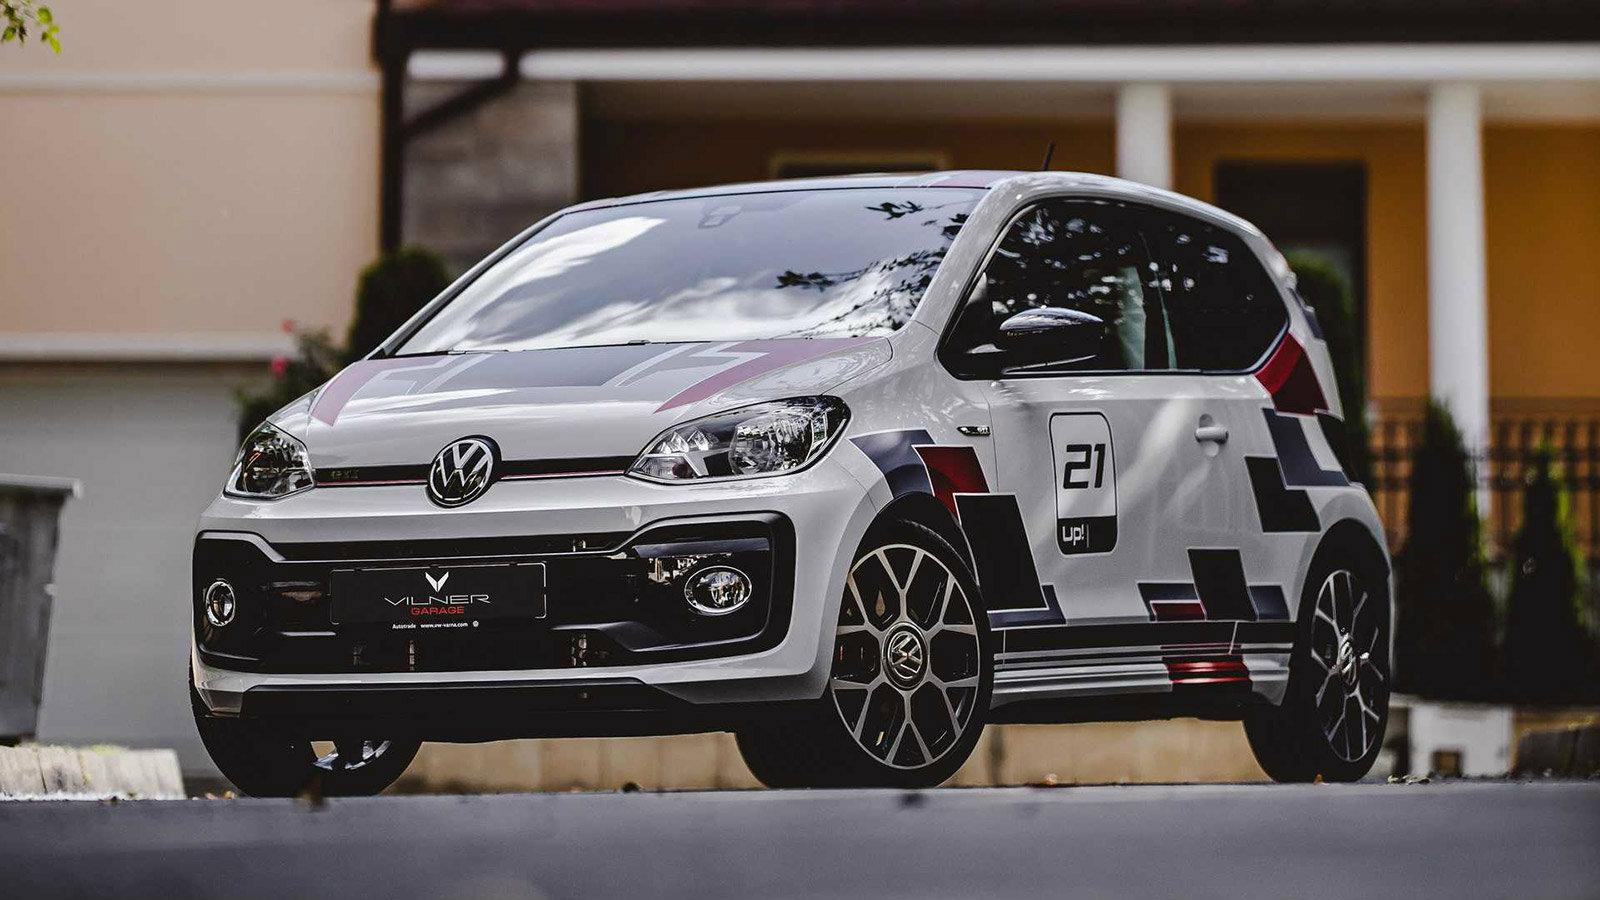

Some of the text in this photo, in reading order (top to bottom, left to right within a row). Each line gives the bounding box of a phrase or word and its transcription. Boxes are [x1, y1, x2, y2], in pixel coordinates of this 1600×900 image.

[1063, 443, 1106, 489] 21
[1062, 524, 1085, 546] up!
[384, 595, 490, 605] VILNER
[410, 606, 464, 615] GARAGE
